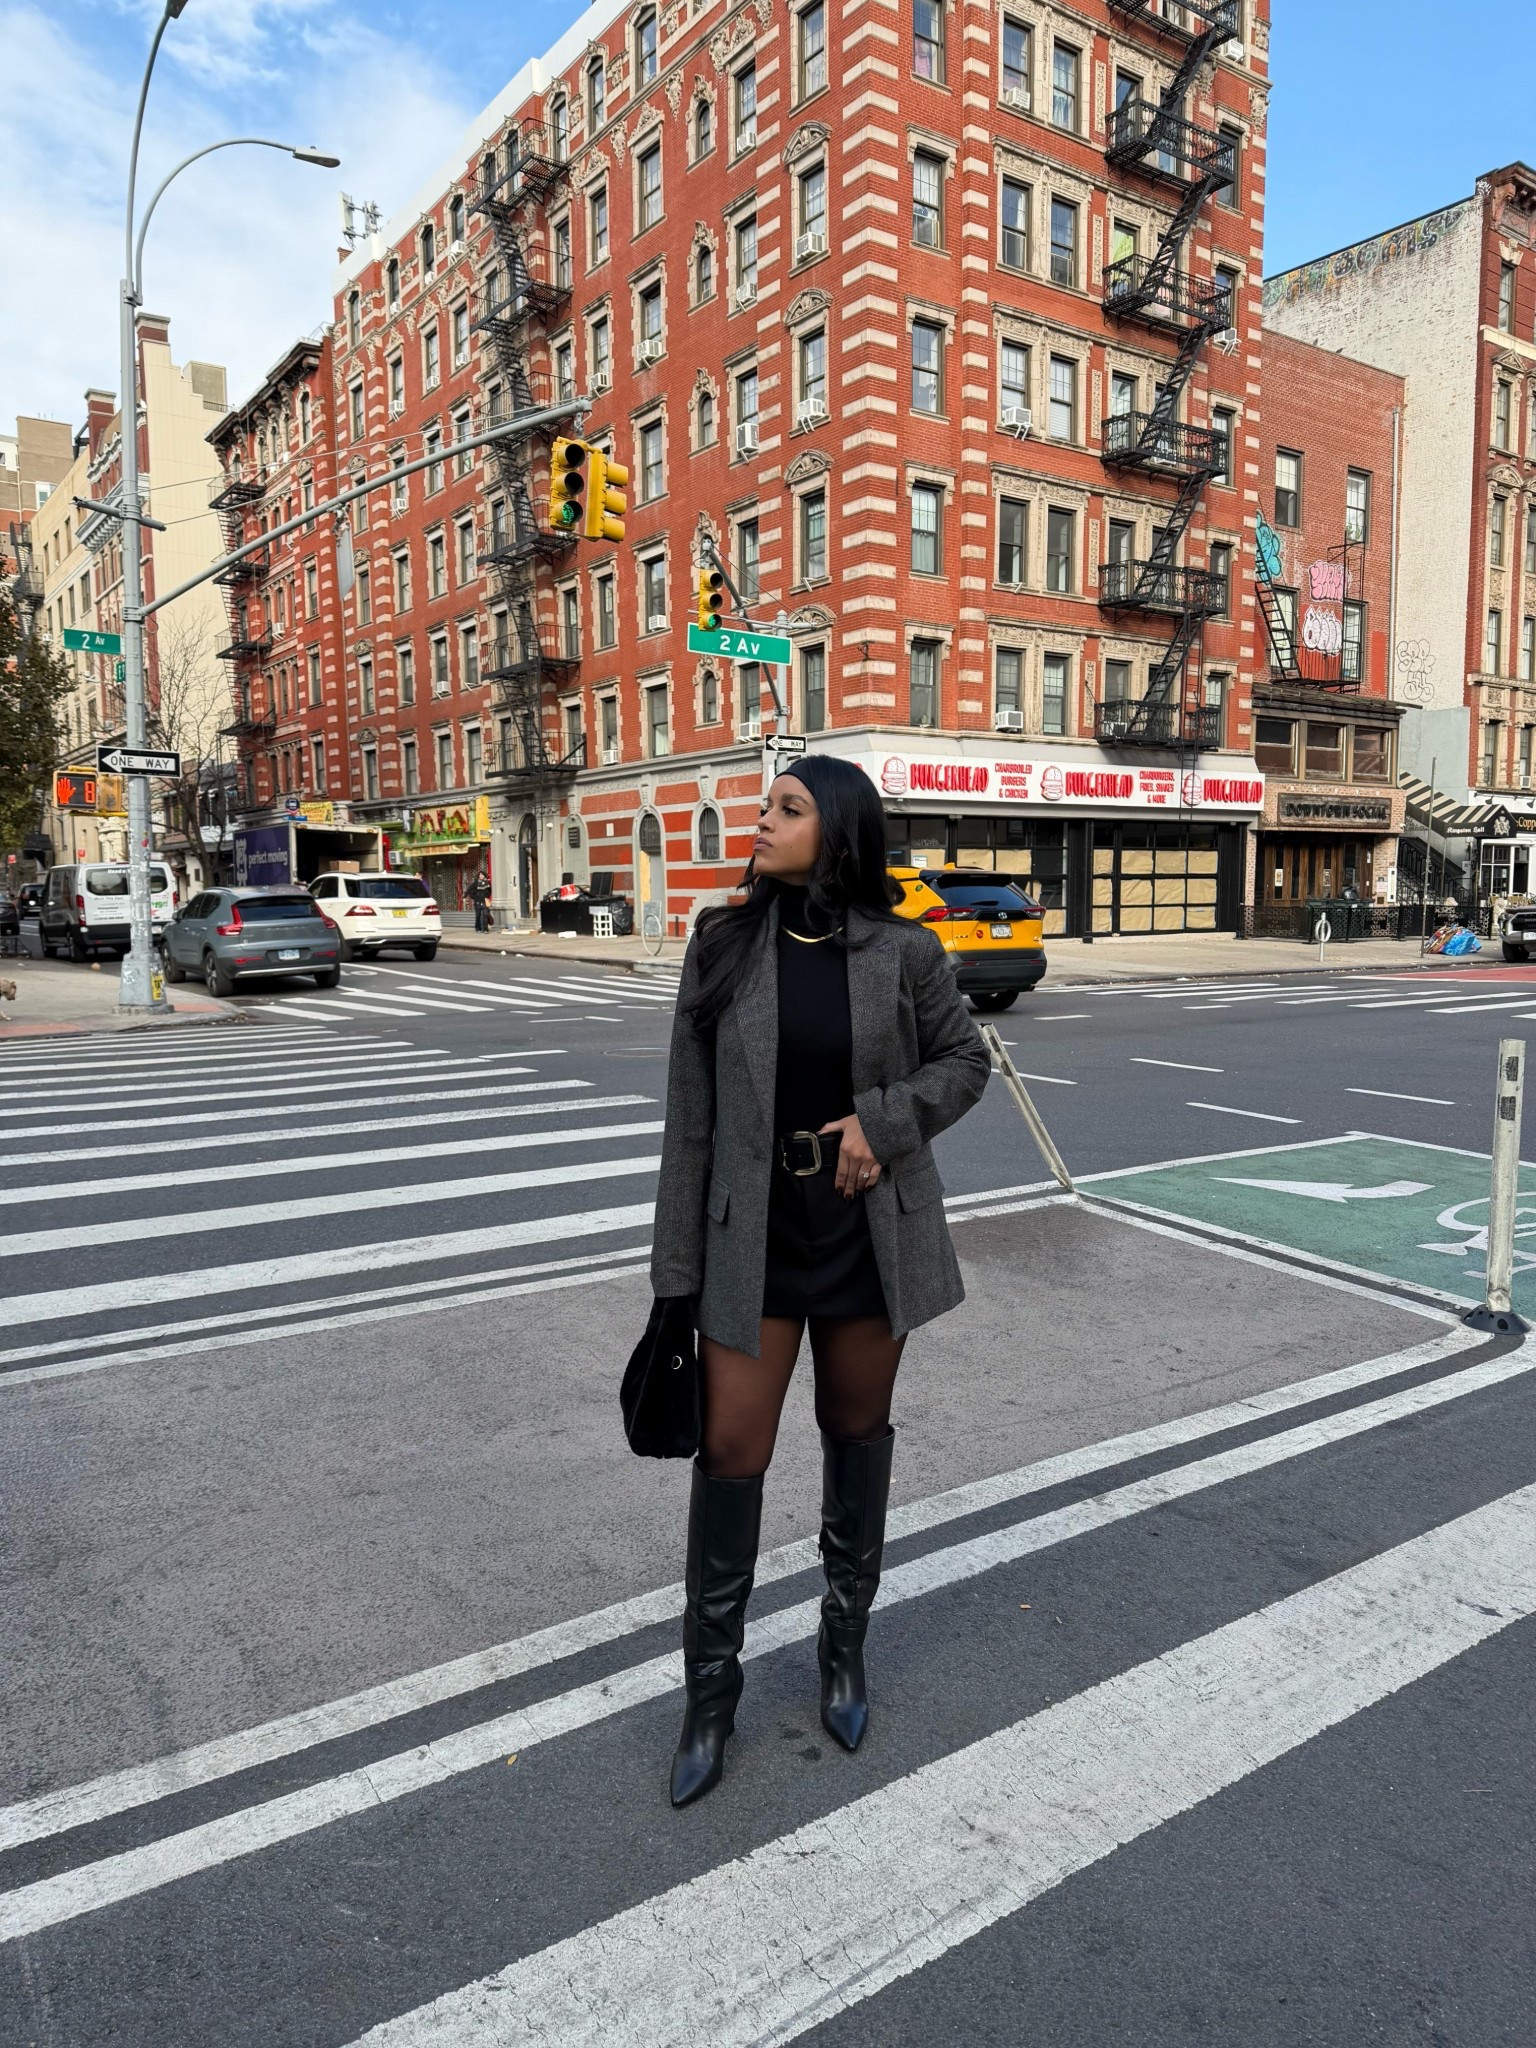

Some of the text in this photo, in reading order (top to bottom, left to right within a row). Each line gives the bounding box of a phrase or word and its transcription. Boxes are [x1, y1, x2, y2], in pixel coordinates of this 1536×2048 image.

[82, 634, 105, 649] 2 Av
[720, 635, 760, 655] 2 Av
[771, 737, 803, 748] ONE WAY
[110, 756, 169, 769] ONE WAY
[994, 763, 1033, 775] CHARBROILED
[910, 763, 989, 793] BURGERHEAD
[1001, 776, 1027, 787] BURGERS
[1065, 771, 1134, 798] BURGERHEAD
[85, 781, 95, 804] 8
[1005, 789, 1028, 799] CHICKEN
[1203, 779, 1262, 803] BURGERHEAD
[1286, 803, 1351, 818] DOWNTOWN
[1518, 816, 1536, 830] Copp
[248, 848, 288, 868] perfect moving
